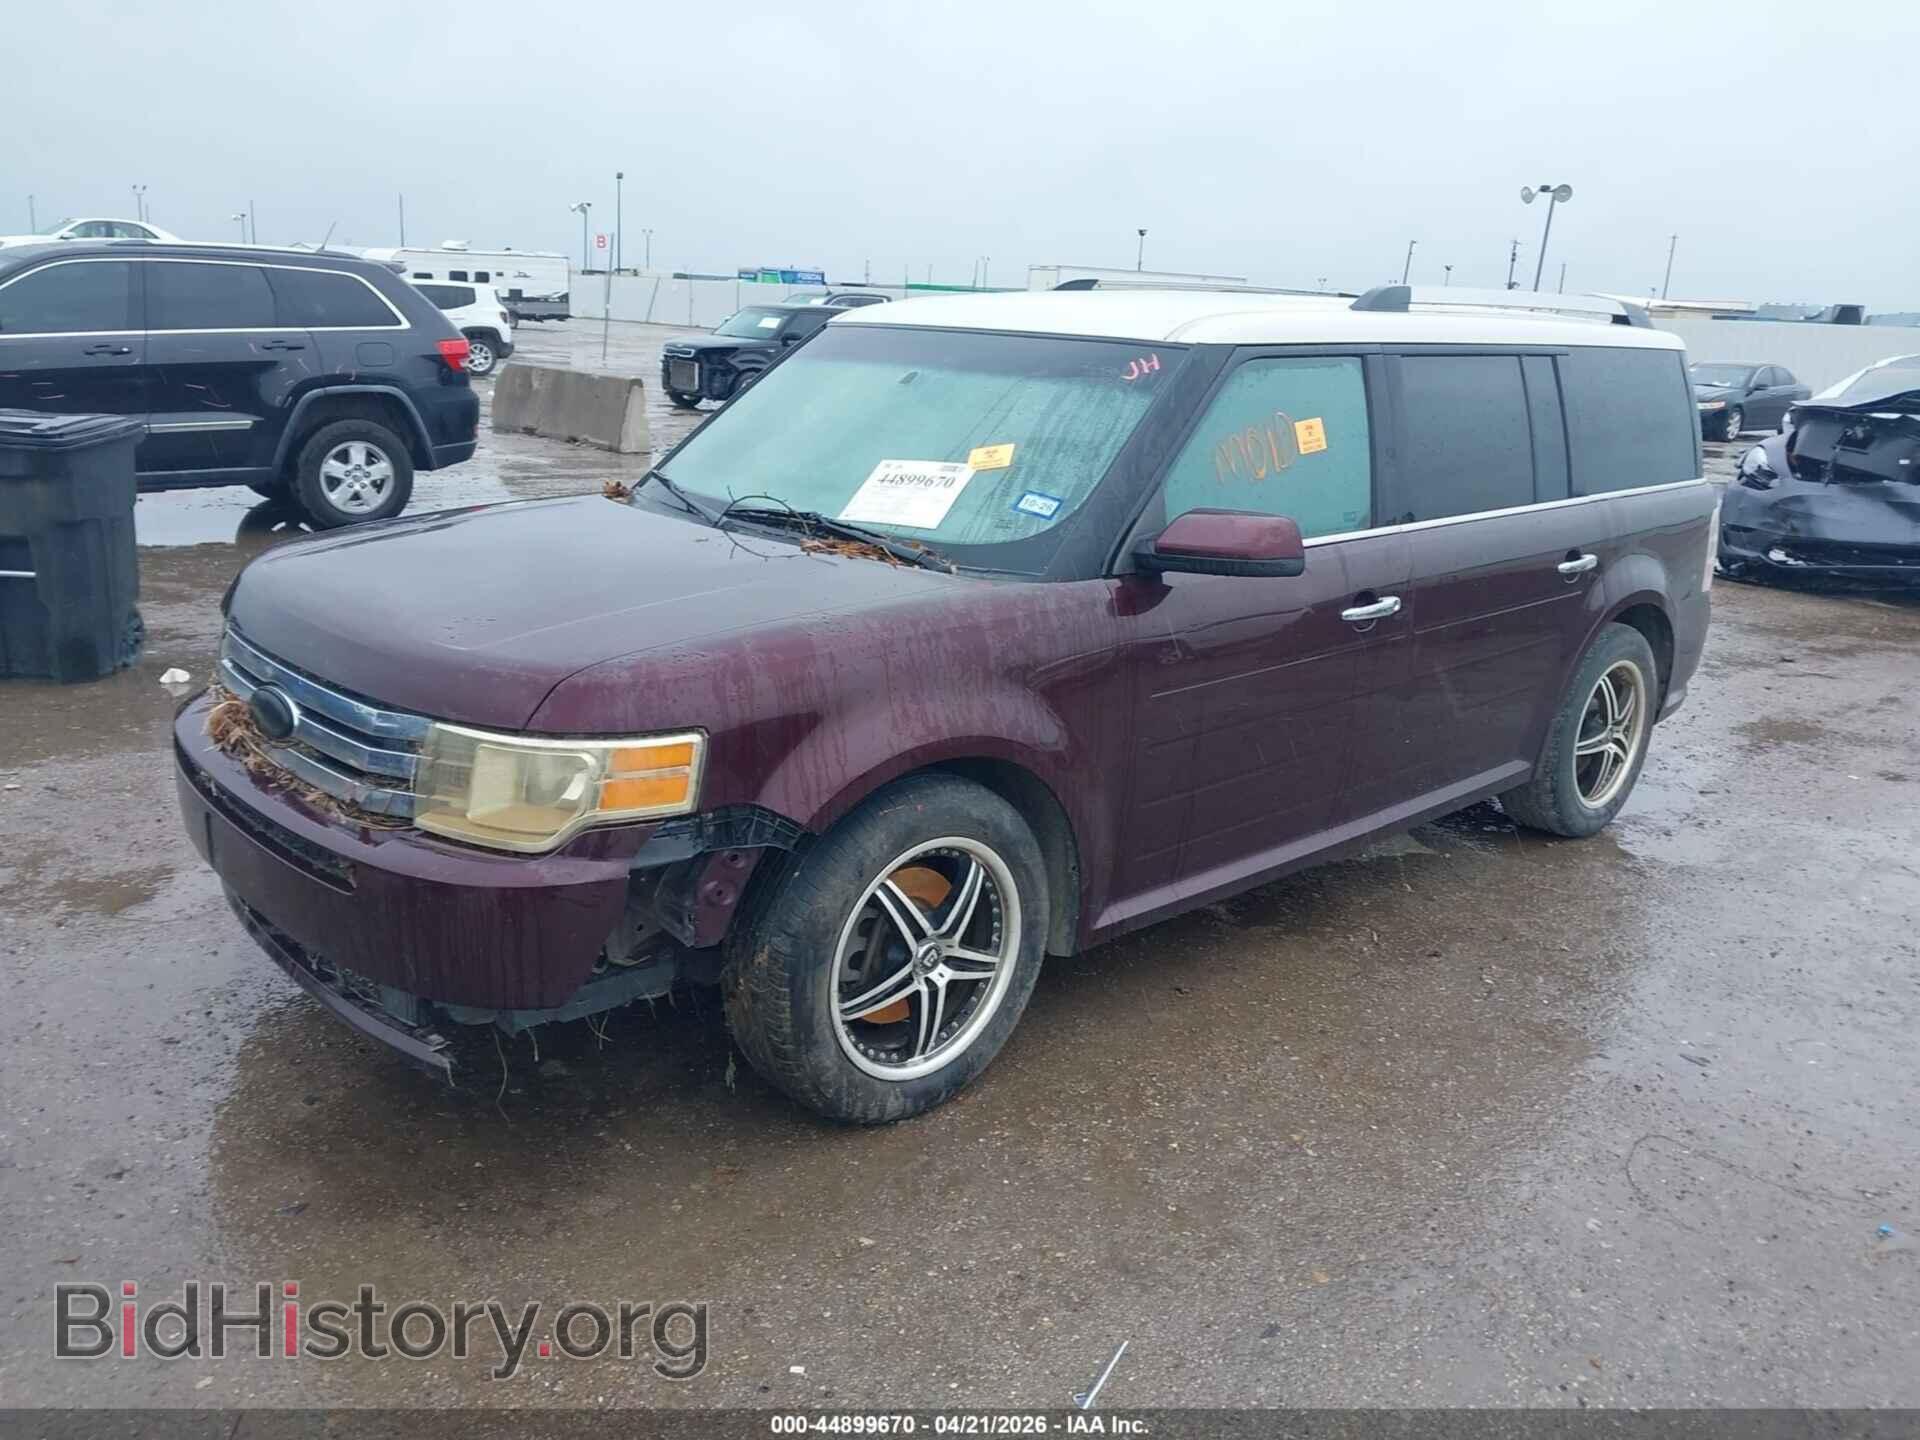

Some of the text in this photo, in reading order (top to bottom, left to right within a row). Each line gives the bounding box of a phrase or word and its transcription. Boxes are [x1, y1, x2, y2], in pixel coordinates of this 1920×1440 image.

[596, 234, 606, 249] B
[1120, 352, 1160, 380] JH
[877, 473, 956, 488] 44899670
